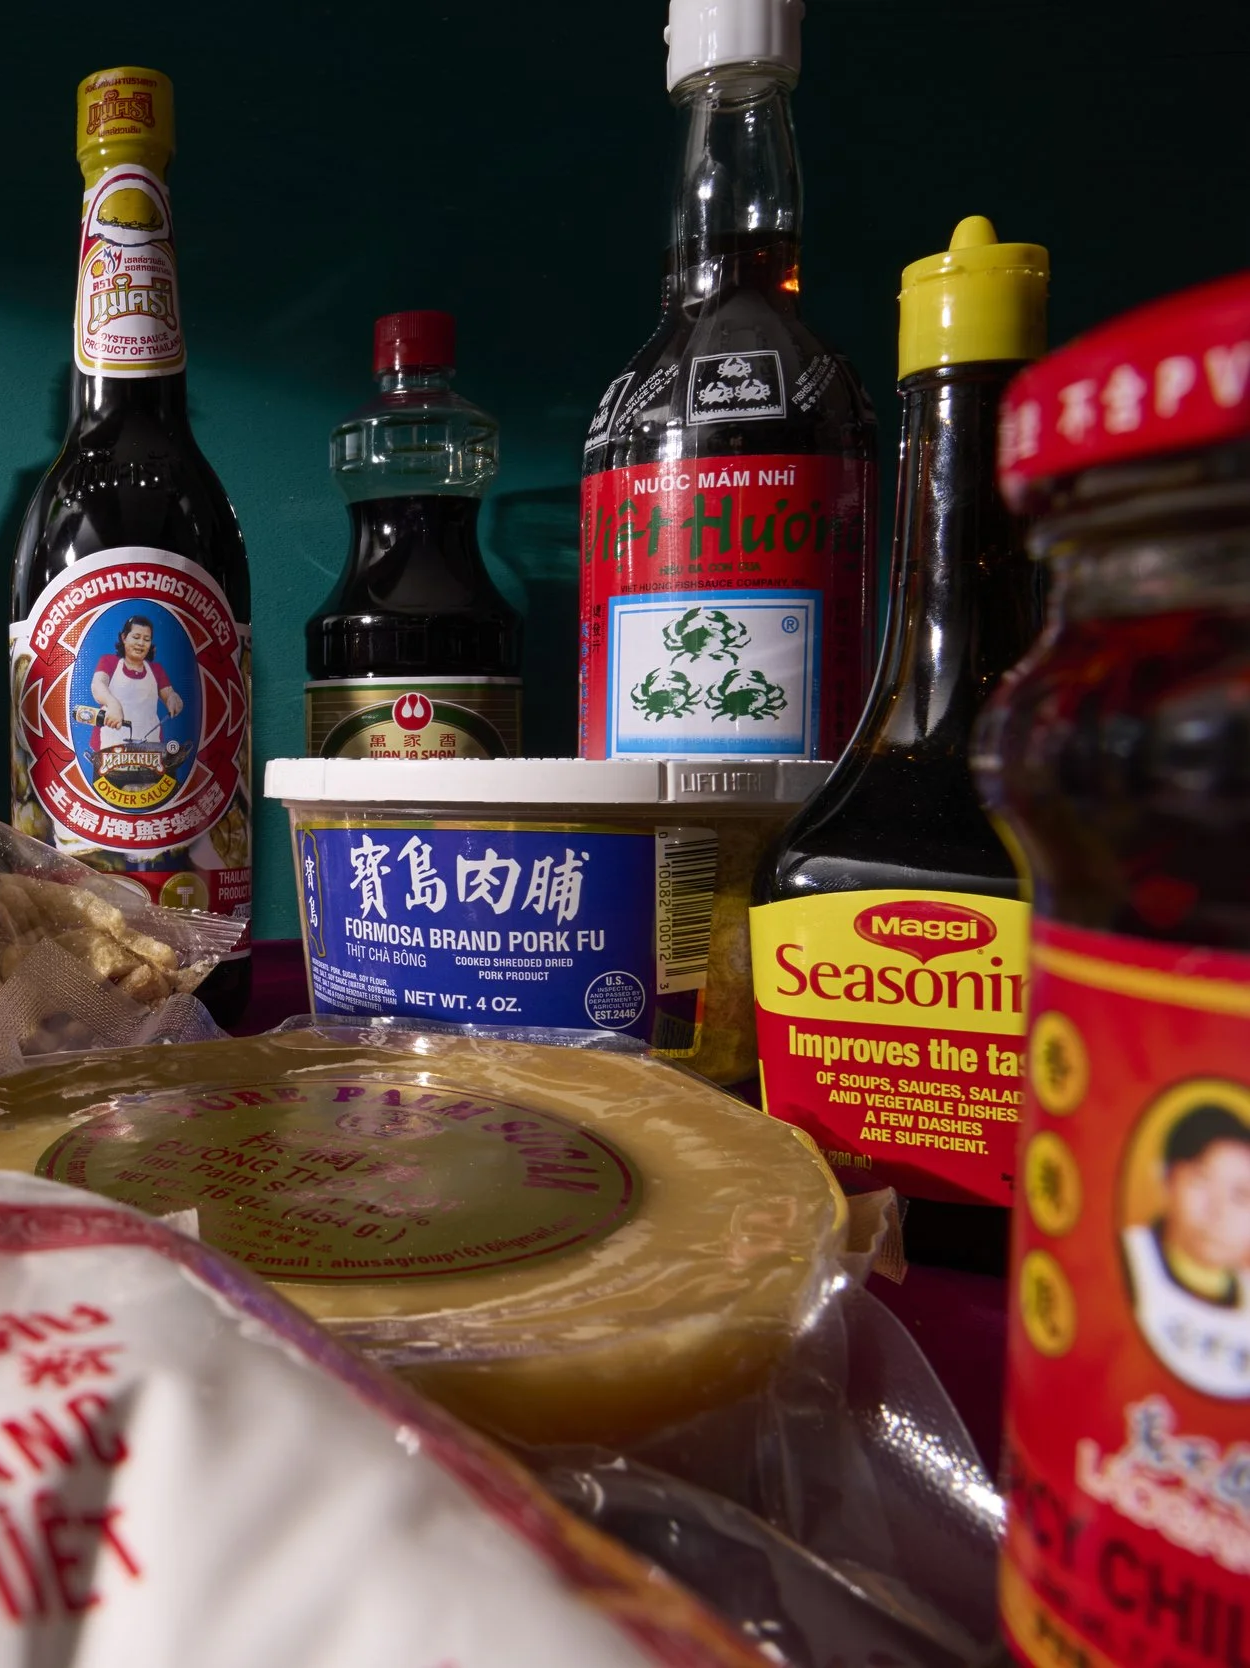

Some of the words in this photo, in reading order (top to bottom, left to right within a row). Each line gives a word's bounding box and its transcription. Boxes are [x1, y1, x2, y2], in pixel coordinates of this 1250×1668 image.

[85, 337, 127, 354] PRODUCT
[130, 346, 145, 355] OF
[147, 334, 181, 354] THAILAND
[101, 333, 138, 345] OYSTER
[140, 332, 169, 344] SAUCE
[794, 371, 810, 387] VIET
[620, 582, 637, 593] VIET
[639, 582, 672, 592] HUONG
[675, 578, 732, 590] FISHSAUCE
[370, 733, 457, 748] 萬家香
[422, 750, 456, 760] SHAN
[98, 781, 137, 805] OYSTER
[141, 778, 173, 803] SAUCE
[681, 772, 719, 793] LIFT
[659, 863, 671, 907] 10082
[345, 917, 424, 947] FORMOSA
[430, 928, 500, 952] BRAND
[509, 930, 570, 952] PORK
[577, 930, 605, 951] FU
[872, 916, 977, 940] Maggi
[659, 917, 671, 961] 10012
[369, 946, 390, 963] CHÀ
[393, 949, 427, 968] BÔNG
[455, 956, 491, 967] COOKED
[493, 957, 542, 967] SHREDDED
[545, 958, 573, 967] DRIED
[359, 974, 369, 982] SOY
[479, 970, 504, 980] PORK
[506, 971, 549, 981] PRODUCT
[606, 976, 624, 986] U.S.
[369, 993, 381, 1002] LESS
[382, 996, 397, 1005] THAN
[405, 989, 440, 1006] NET
[442, 993, 472, 1010] WT.
[476, 996, 486, 1010] 4
[491, 997, 522, 1012] OZ.
[589, 997, 631, 1005] DEPARTMENT
[593, 1002, 638, 1010] AGRICULTURE
[595, 1009, 636, 1020] EST.2446
[789, 1025, 920, 1069] Improves
[928, 1038, 978, 1073] the
[816, 1071, 836, 1085] OF
[839, 1073, 895, 1093] SOUPS,
[898, 1079, 965, 1101] SAUCES,
[969, 1086, 1025, 1105] SALAD
[333, 1086, 495, 1121] PALM
[829, 1089, 861, 1105] AND
[865, 1093, 954, 1115] VEGETABLE
[958, 1103, 1022, 1122] DISHES.
[865, 1110, 876, 1123] A
[880, 1113, 914, 1128] FEW
[918, 1118, 983, 1136] DASHES
[860, 1126, 891, 1143] ARE
[895, 1130, 989, 1155] SUFFICIENT.
[189, 1164, 258, 1188] Palm
[114, 1170, 153, 1185] NET
[197, 1183, 236, 1200] 16
[281, 1204, 356, 1229] (454
[244, 1252, 309, 1268] E-mail
